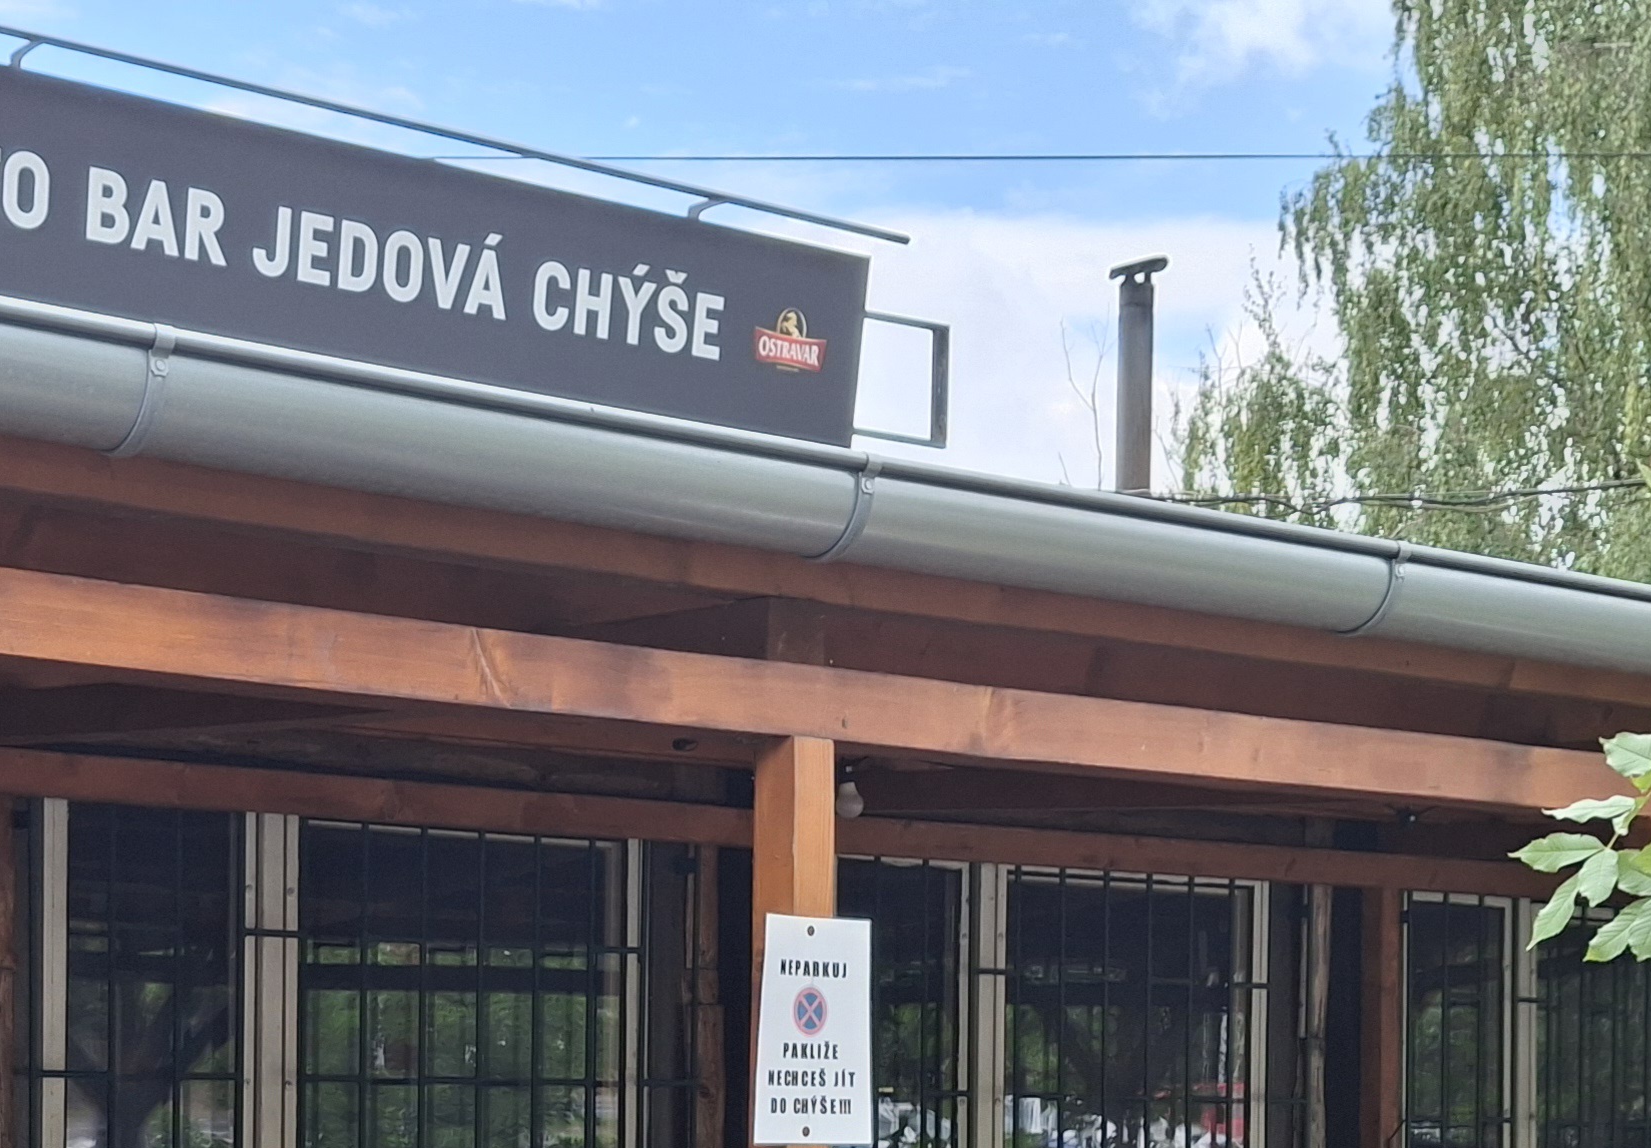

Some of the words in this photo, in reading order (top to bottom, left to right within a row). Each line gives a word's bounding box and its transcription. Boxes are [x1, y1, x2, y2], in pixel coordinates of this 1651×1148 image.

[85, 166, 228, 267] BAR
[251, 205, 507, 321] JEDOVÁ
[532, 261, 725, 361] CHÝŠE
[758, 335, 819, 367] OSTRAVAR
[780, 958, 847, 979] NEPARKUJ
[782, 1041, 839, 1060] PAKLIŽE
[768, 1068, 826, 1088] NECHCEŠ
[833, 1068, 856, 1088] JÍT
[770, 1097, 787, 1114] DO
[793, 1095, 852, 1115] CHÝŠE!!!
